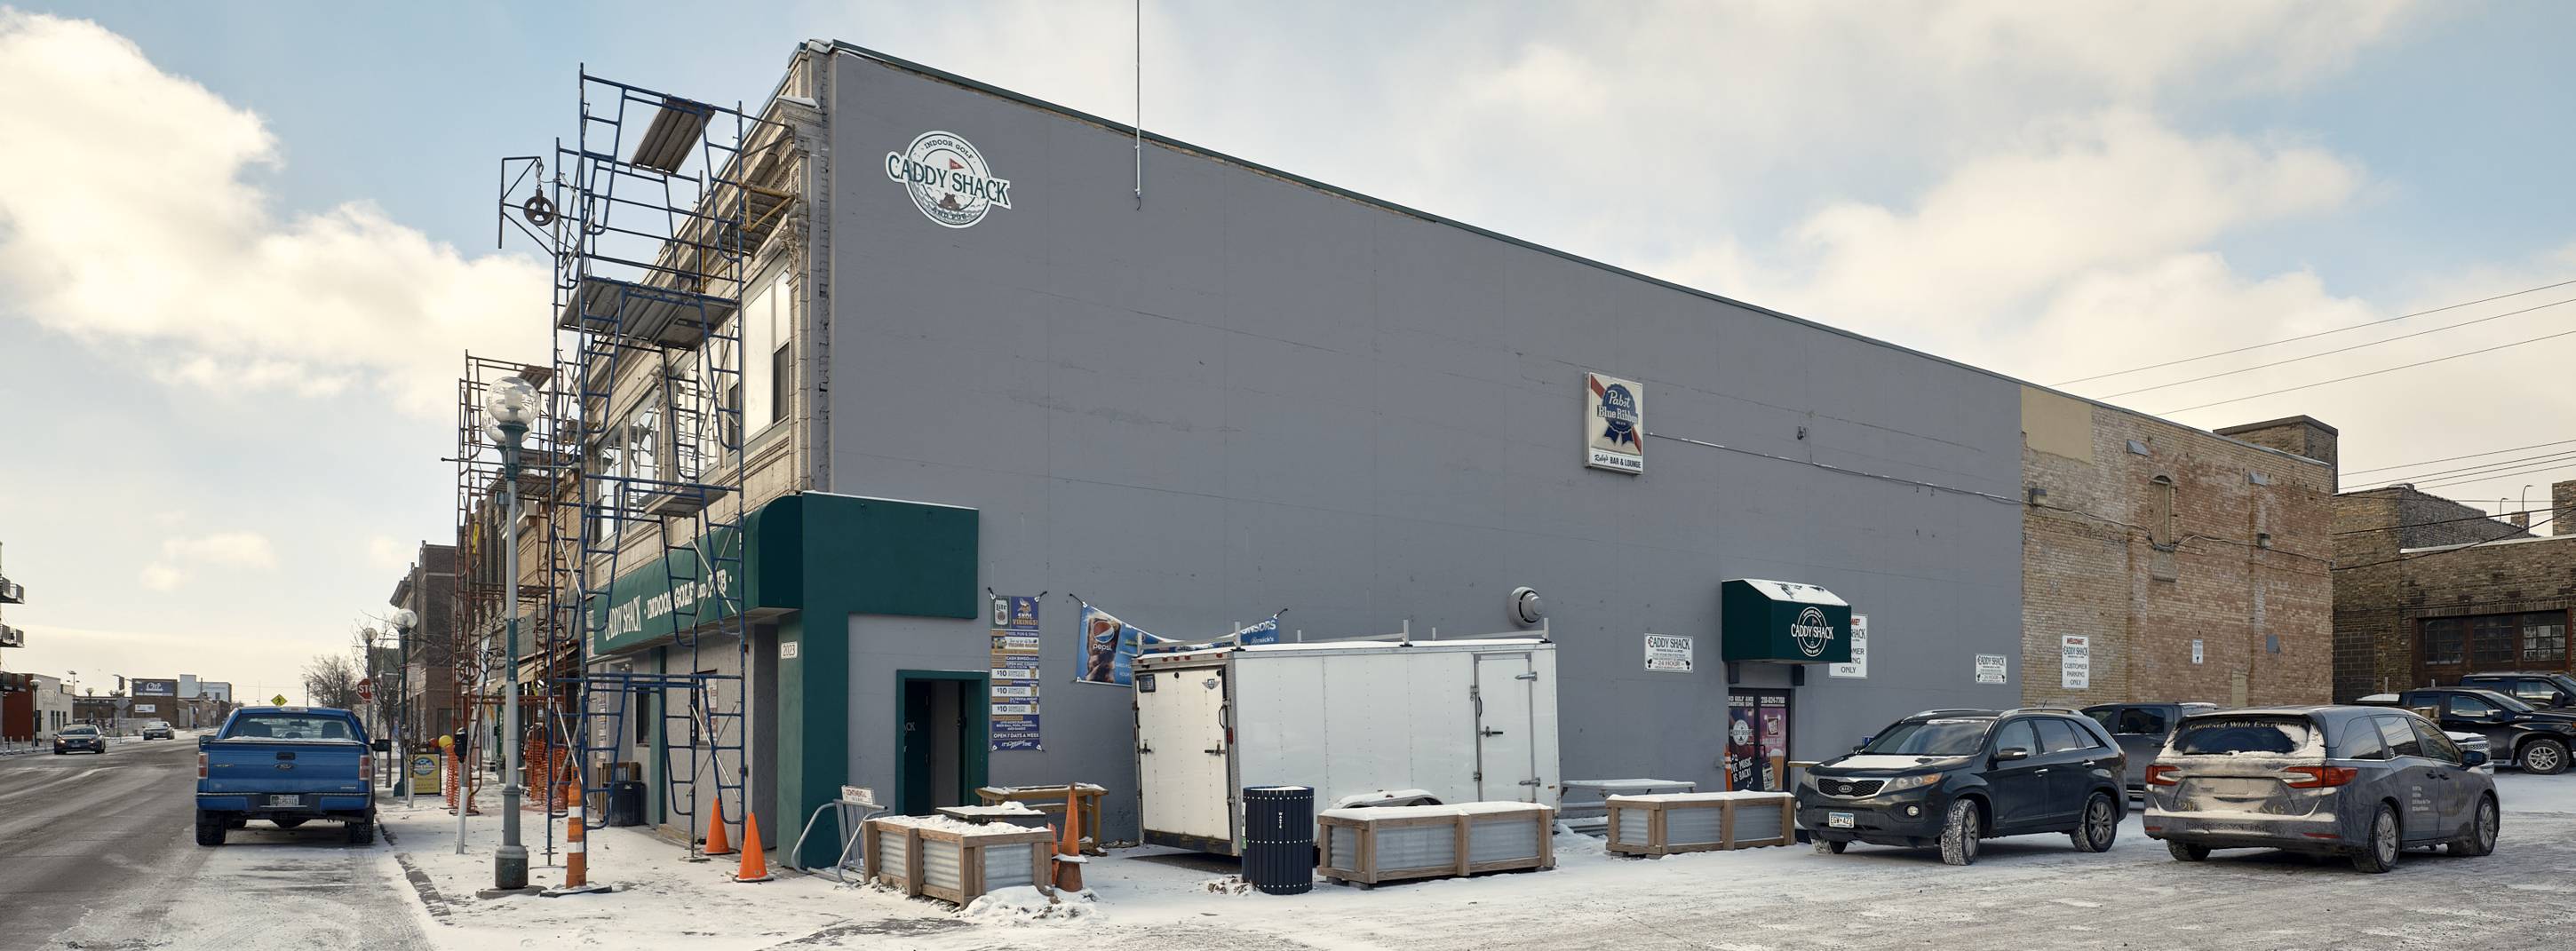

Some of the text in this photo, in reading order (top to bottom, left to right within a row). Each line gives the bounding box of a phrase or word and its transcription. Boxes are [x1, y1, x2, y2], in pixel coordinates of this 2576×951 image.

[924, 139, 974, 159] INDOOR GOLF
[888, 155, 1009, 206] CADDY SHACK
[1608, 390, 1631, 408] Pabst
[1598, 405, 1638, 424] Blue Ribbon
[1610, 456, 1619, 465] BAR
[1625, 459, 1642, 469] LOUNGE
[623, 595, 641, 633] SHACK
[675, 581, 694, 609] GOLF
[1791, 623, 1834, 639] CADDY SHACK
[1850, 628, 1866, 639] HACK
[1648, 636, 1690, 650] CADDY SHACK
[358, 685, 372, 693] ST
